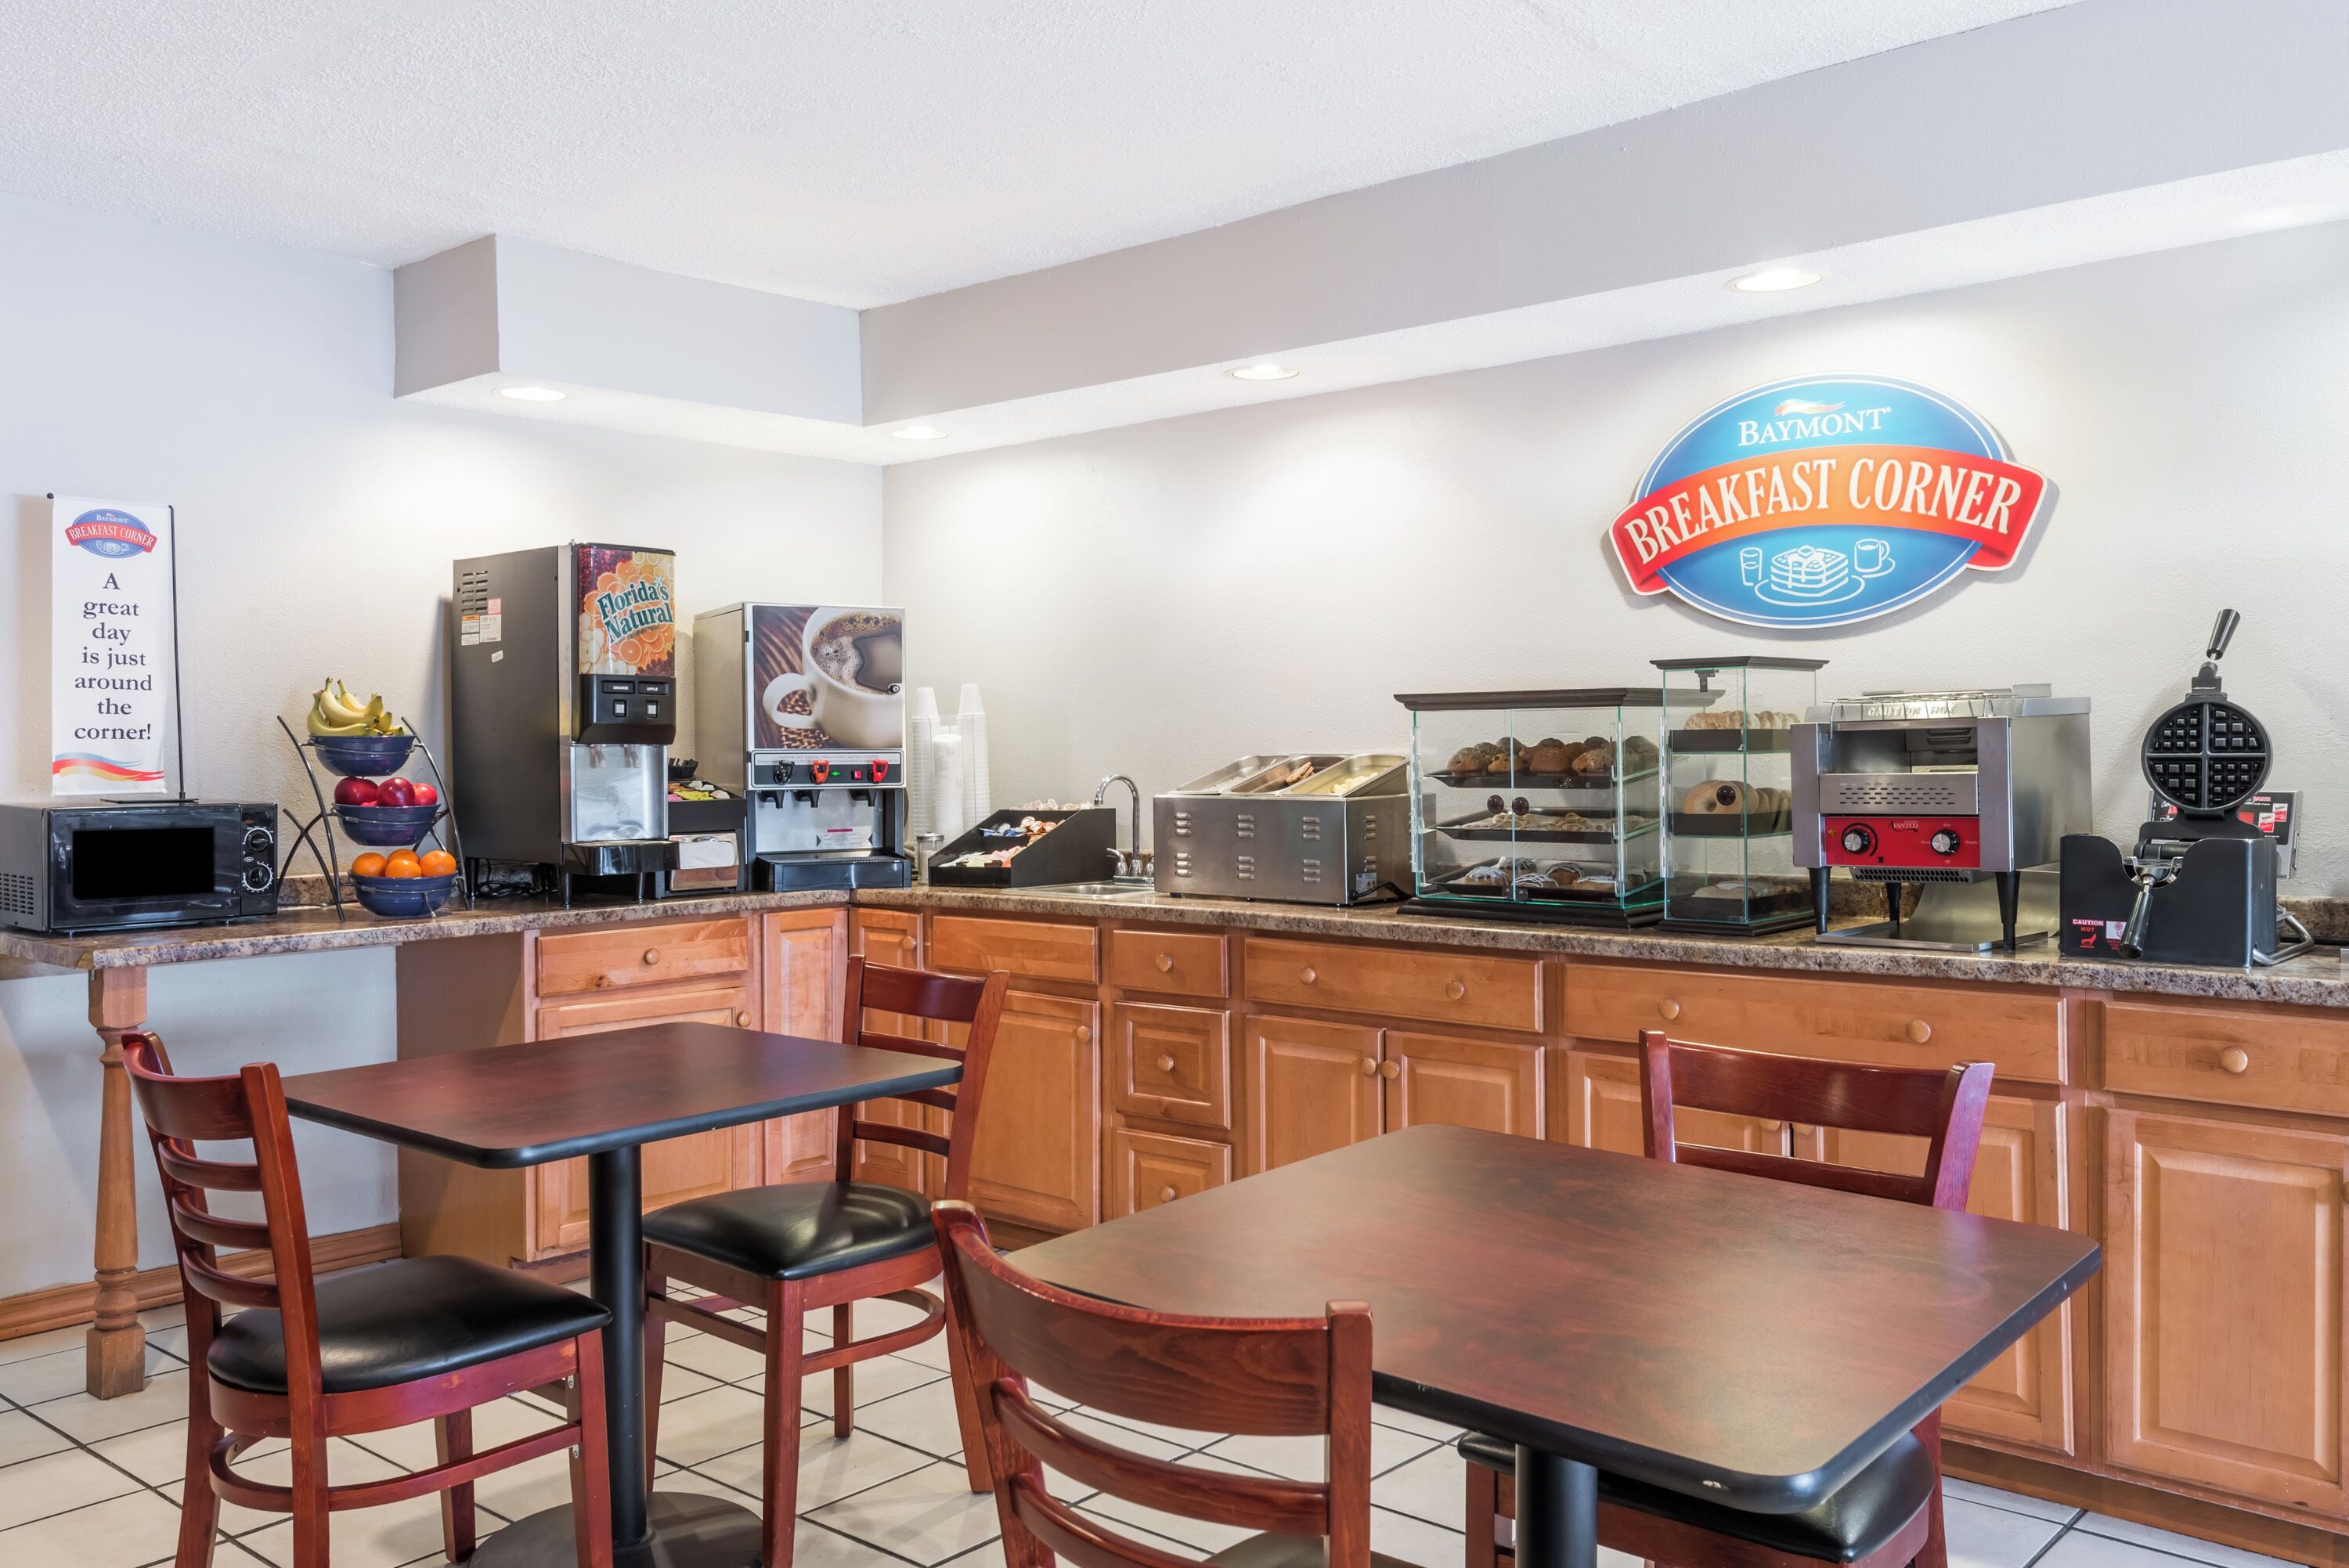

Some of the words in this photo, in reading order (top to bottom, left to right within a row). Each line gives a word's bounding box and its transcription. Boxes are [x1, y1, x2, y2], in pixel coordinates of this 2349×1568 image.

[1737, 406, 1889, 447] BAYMONT
[96, 514, 129, 524] BAYMONT
[1624, 458, 1837, 565] BREAKFAST
[1849, 457, 2022, 535] CORNER
[68, 524, 118, 540] BREAKFAST
[120, 528, 154, 547] CORNER
[102, 572, 121, 590] A
[82, 601, 140, 620] great
[604, 602, 673, 643] Natural
[92, 622, 132, 646] day
[81, 646, 100, 665] is
[106, 647, 147, 670] just
[74, 674, 153, 691] around
[96, 697, 132, 716] the
[74, 723, 151, 741] corner!
